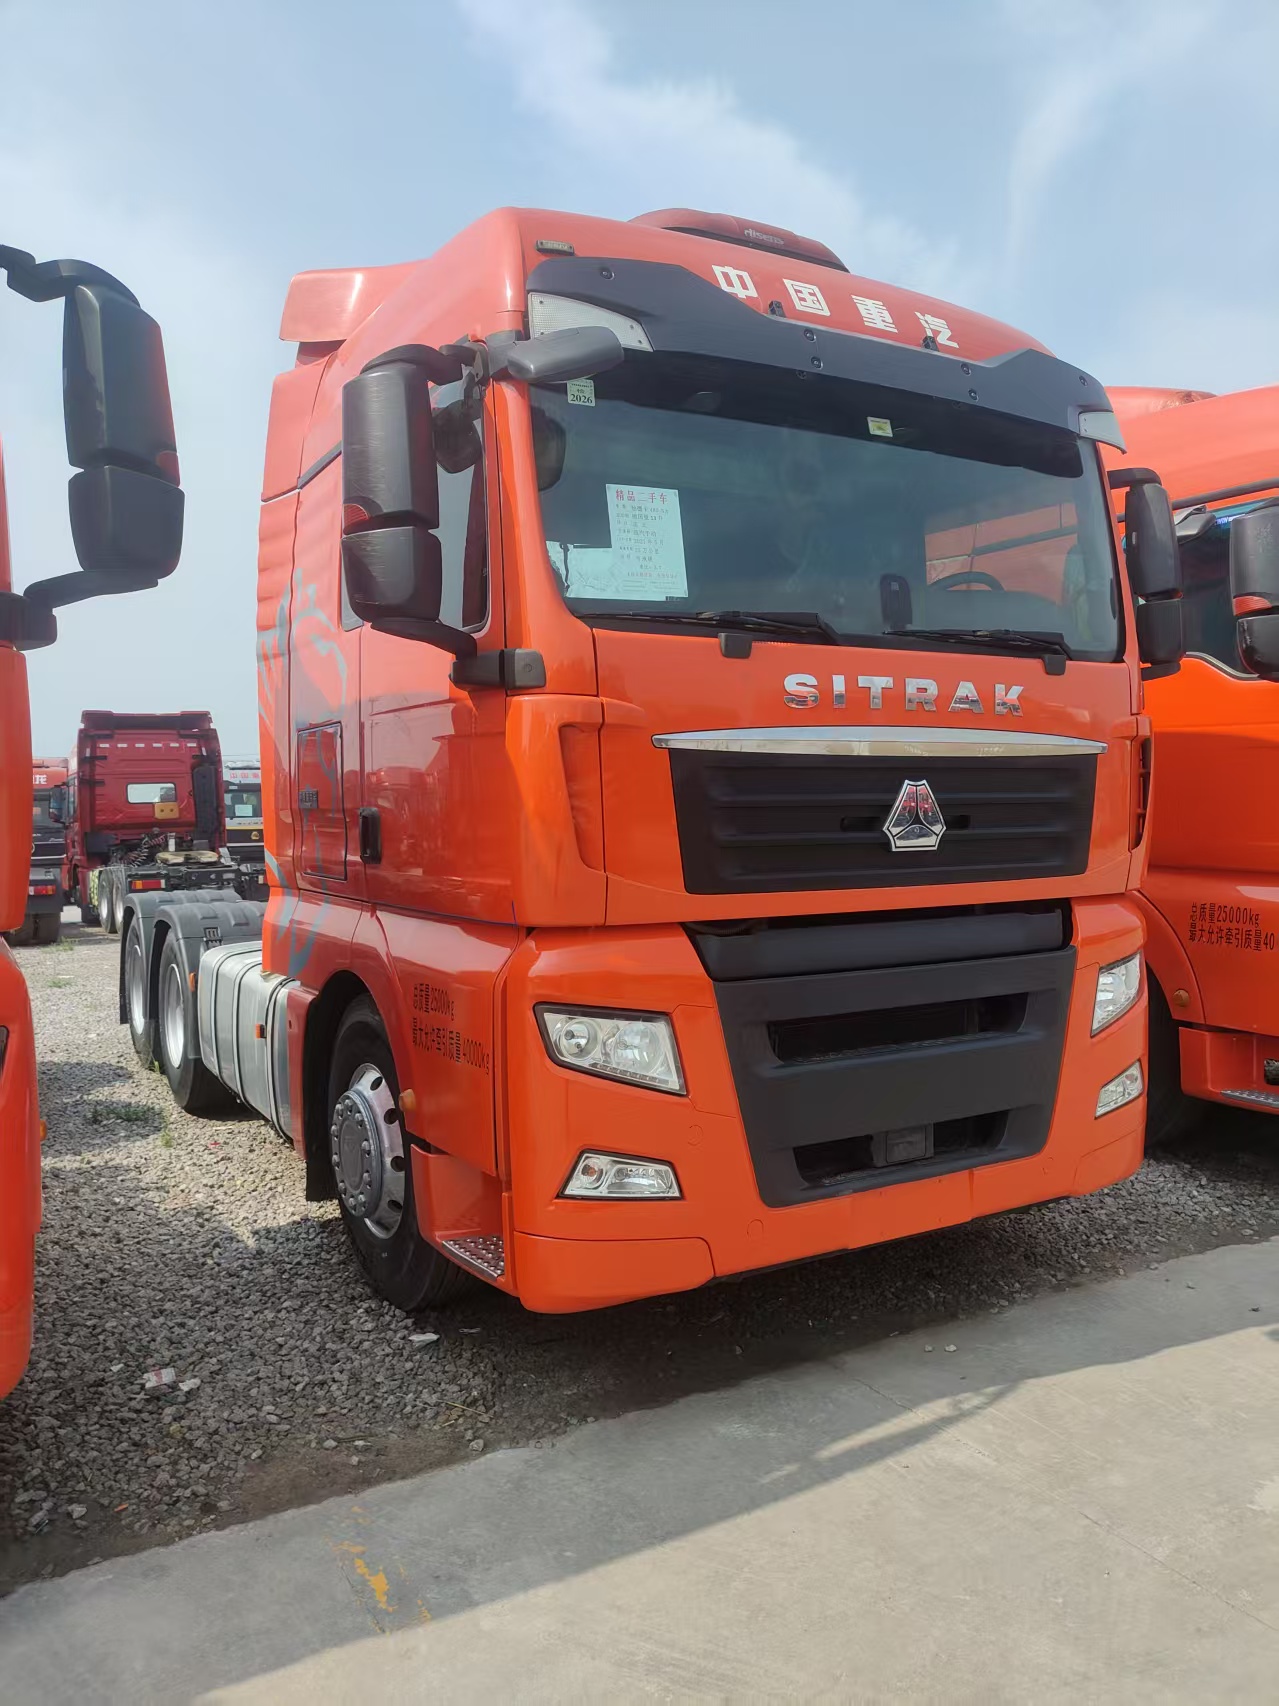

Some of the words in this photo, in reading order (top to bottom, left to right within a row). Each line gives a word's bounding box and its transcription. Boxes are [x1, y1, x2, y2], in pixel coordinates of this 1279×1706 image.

[711, 263, 960, 349] 中国重汽
[570, 393, 593, 404] 2026
[615, 488, 668, 504] 精品二手车
[783, 673, 1025, 718] SITRAK
[1189, 901, 1261, 928] 总质量25000kg
